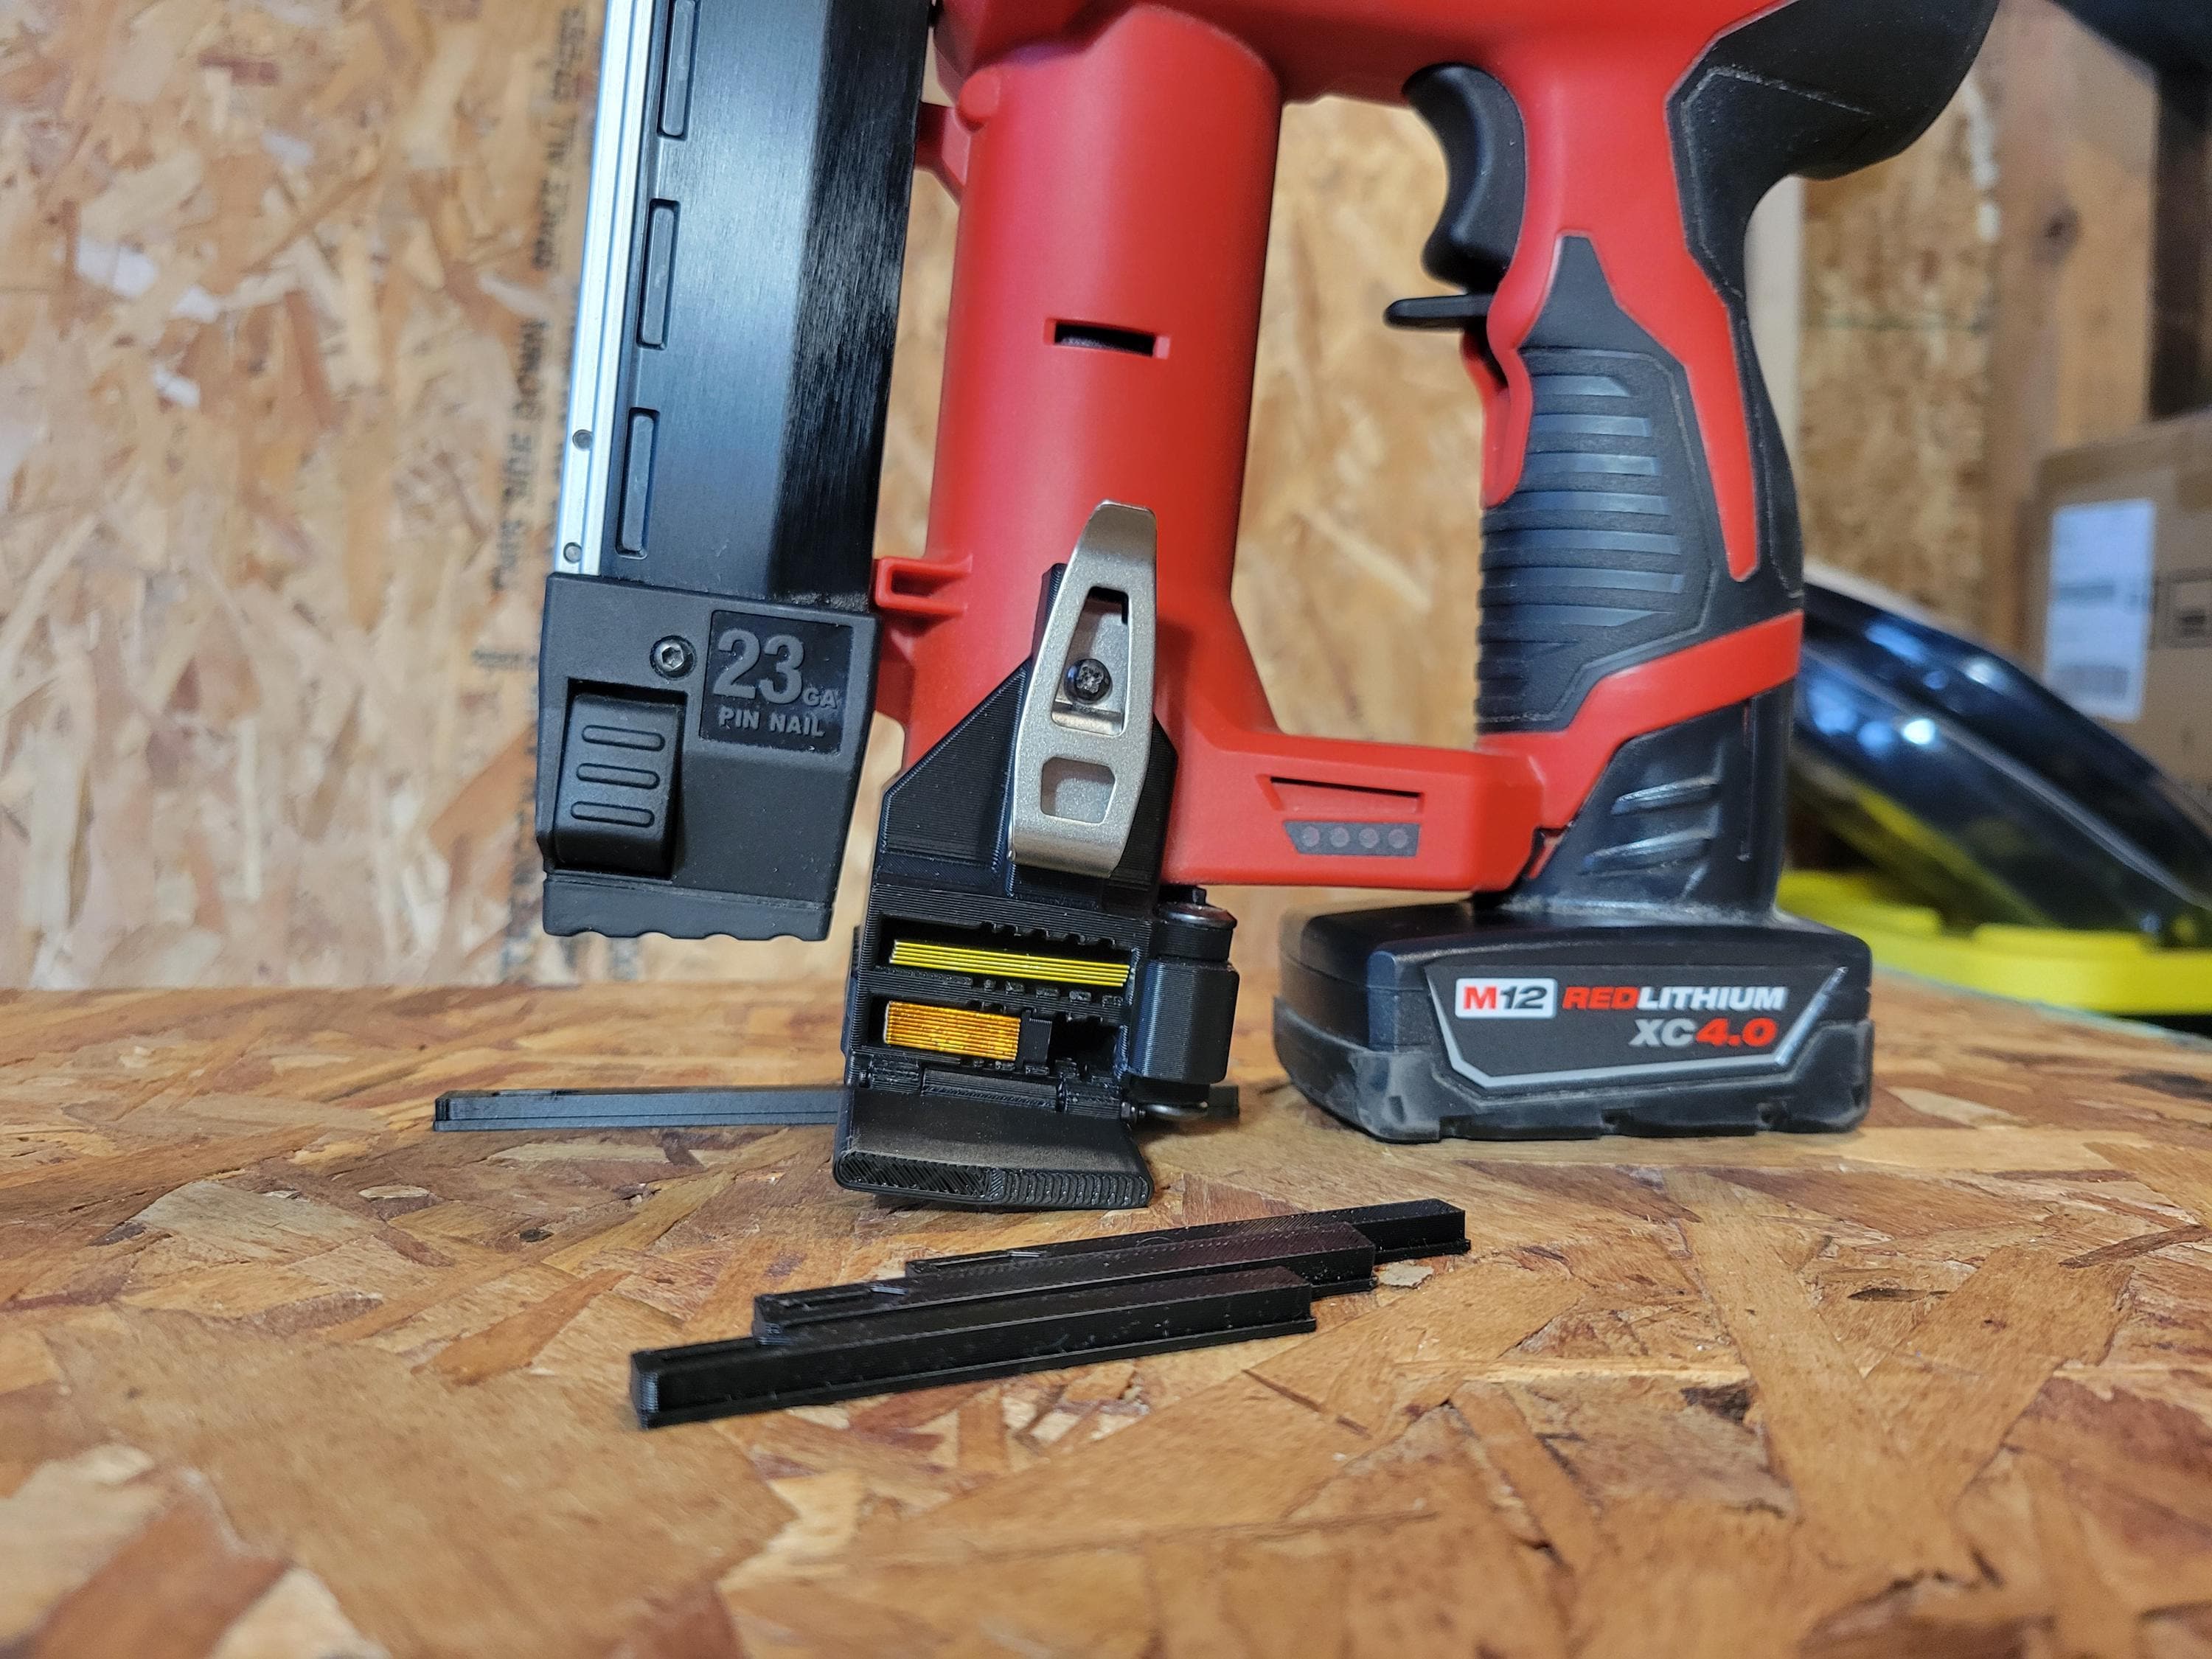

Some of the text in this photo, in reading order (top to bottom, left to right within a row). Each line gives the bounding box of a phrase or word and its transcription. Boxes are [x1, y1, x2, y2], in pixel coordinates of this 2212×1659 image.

[718, 705, 825, 737] PIN NAIL
[1463, 986, 1788, 1011] M12 REDLITHIUM
[1629, 1018, 1778, 1047] XC4.0
